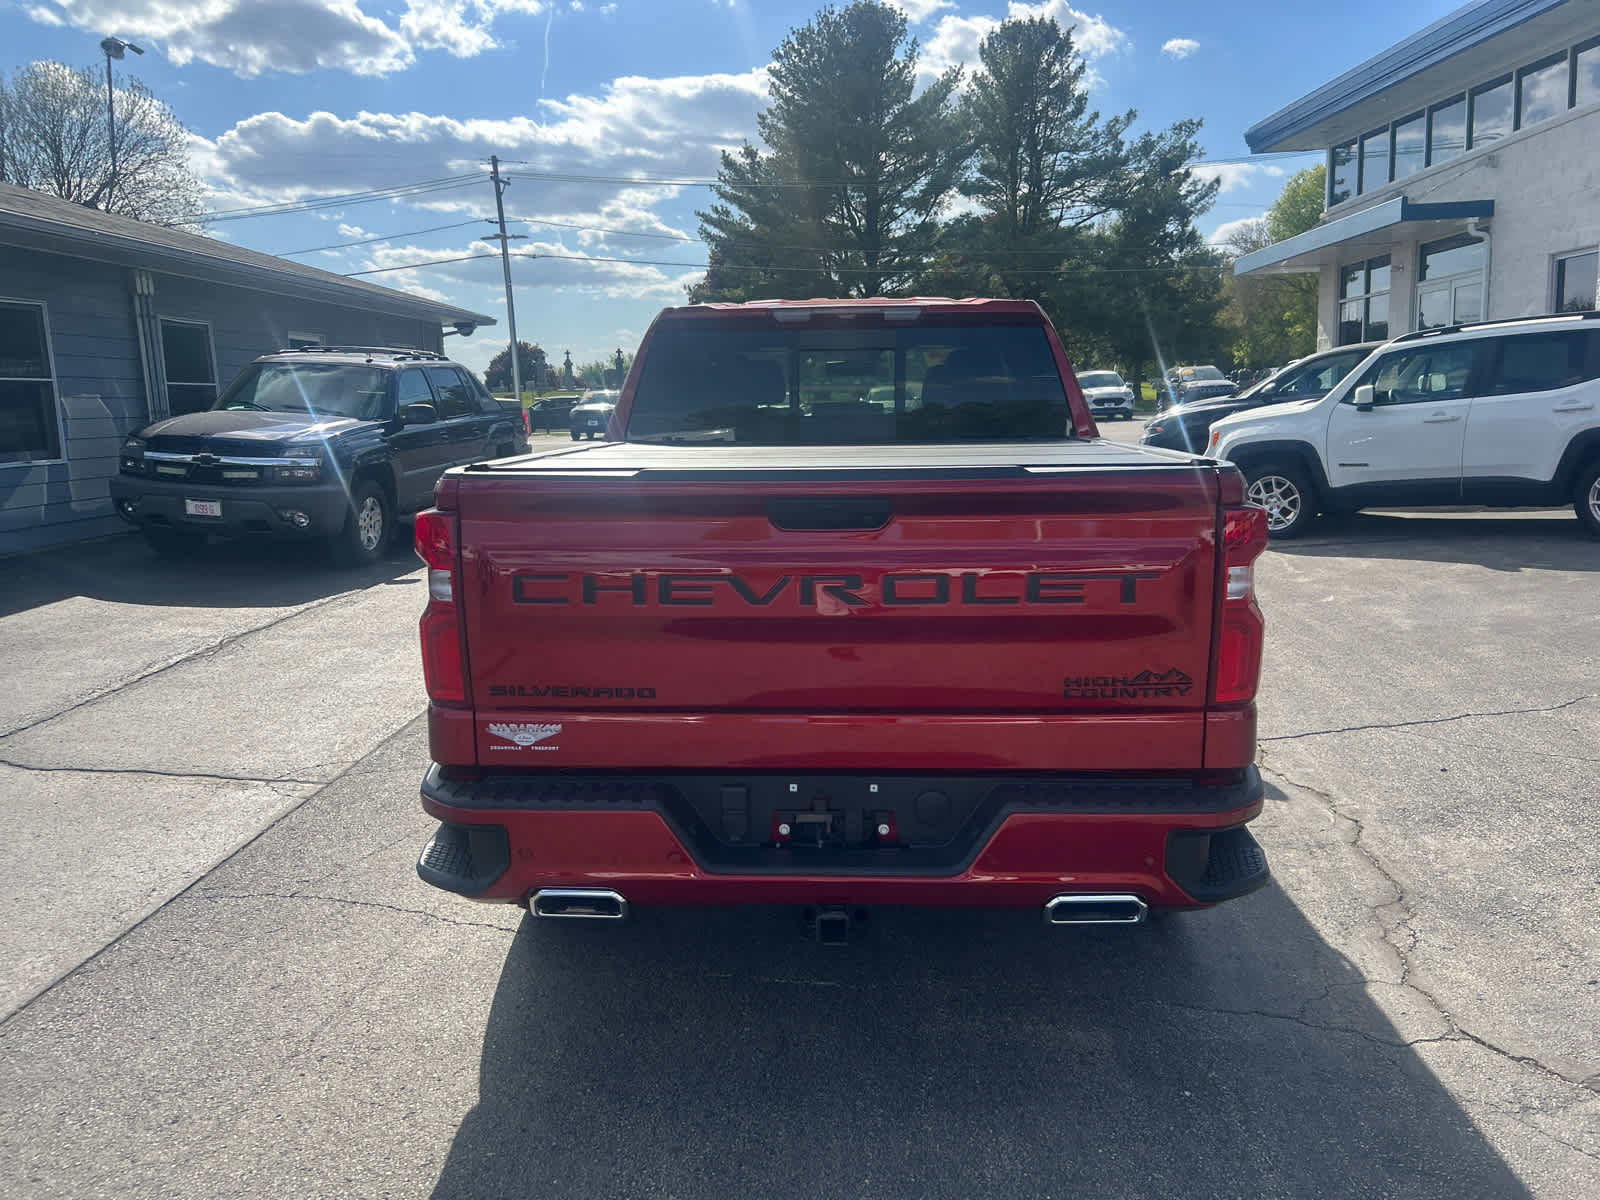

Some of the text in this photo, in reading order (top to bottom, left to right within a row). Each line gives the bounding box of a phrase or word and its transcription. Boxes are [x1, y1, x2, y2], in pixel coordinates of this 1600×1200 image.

[512, 573, 1161, 605] CHEVROLET
[1064, 676, 1129, 687] HIGH
[489, 685, 657, 698] SILVERADO
[1064, 687, 1192, 698] COUNTRY
